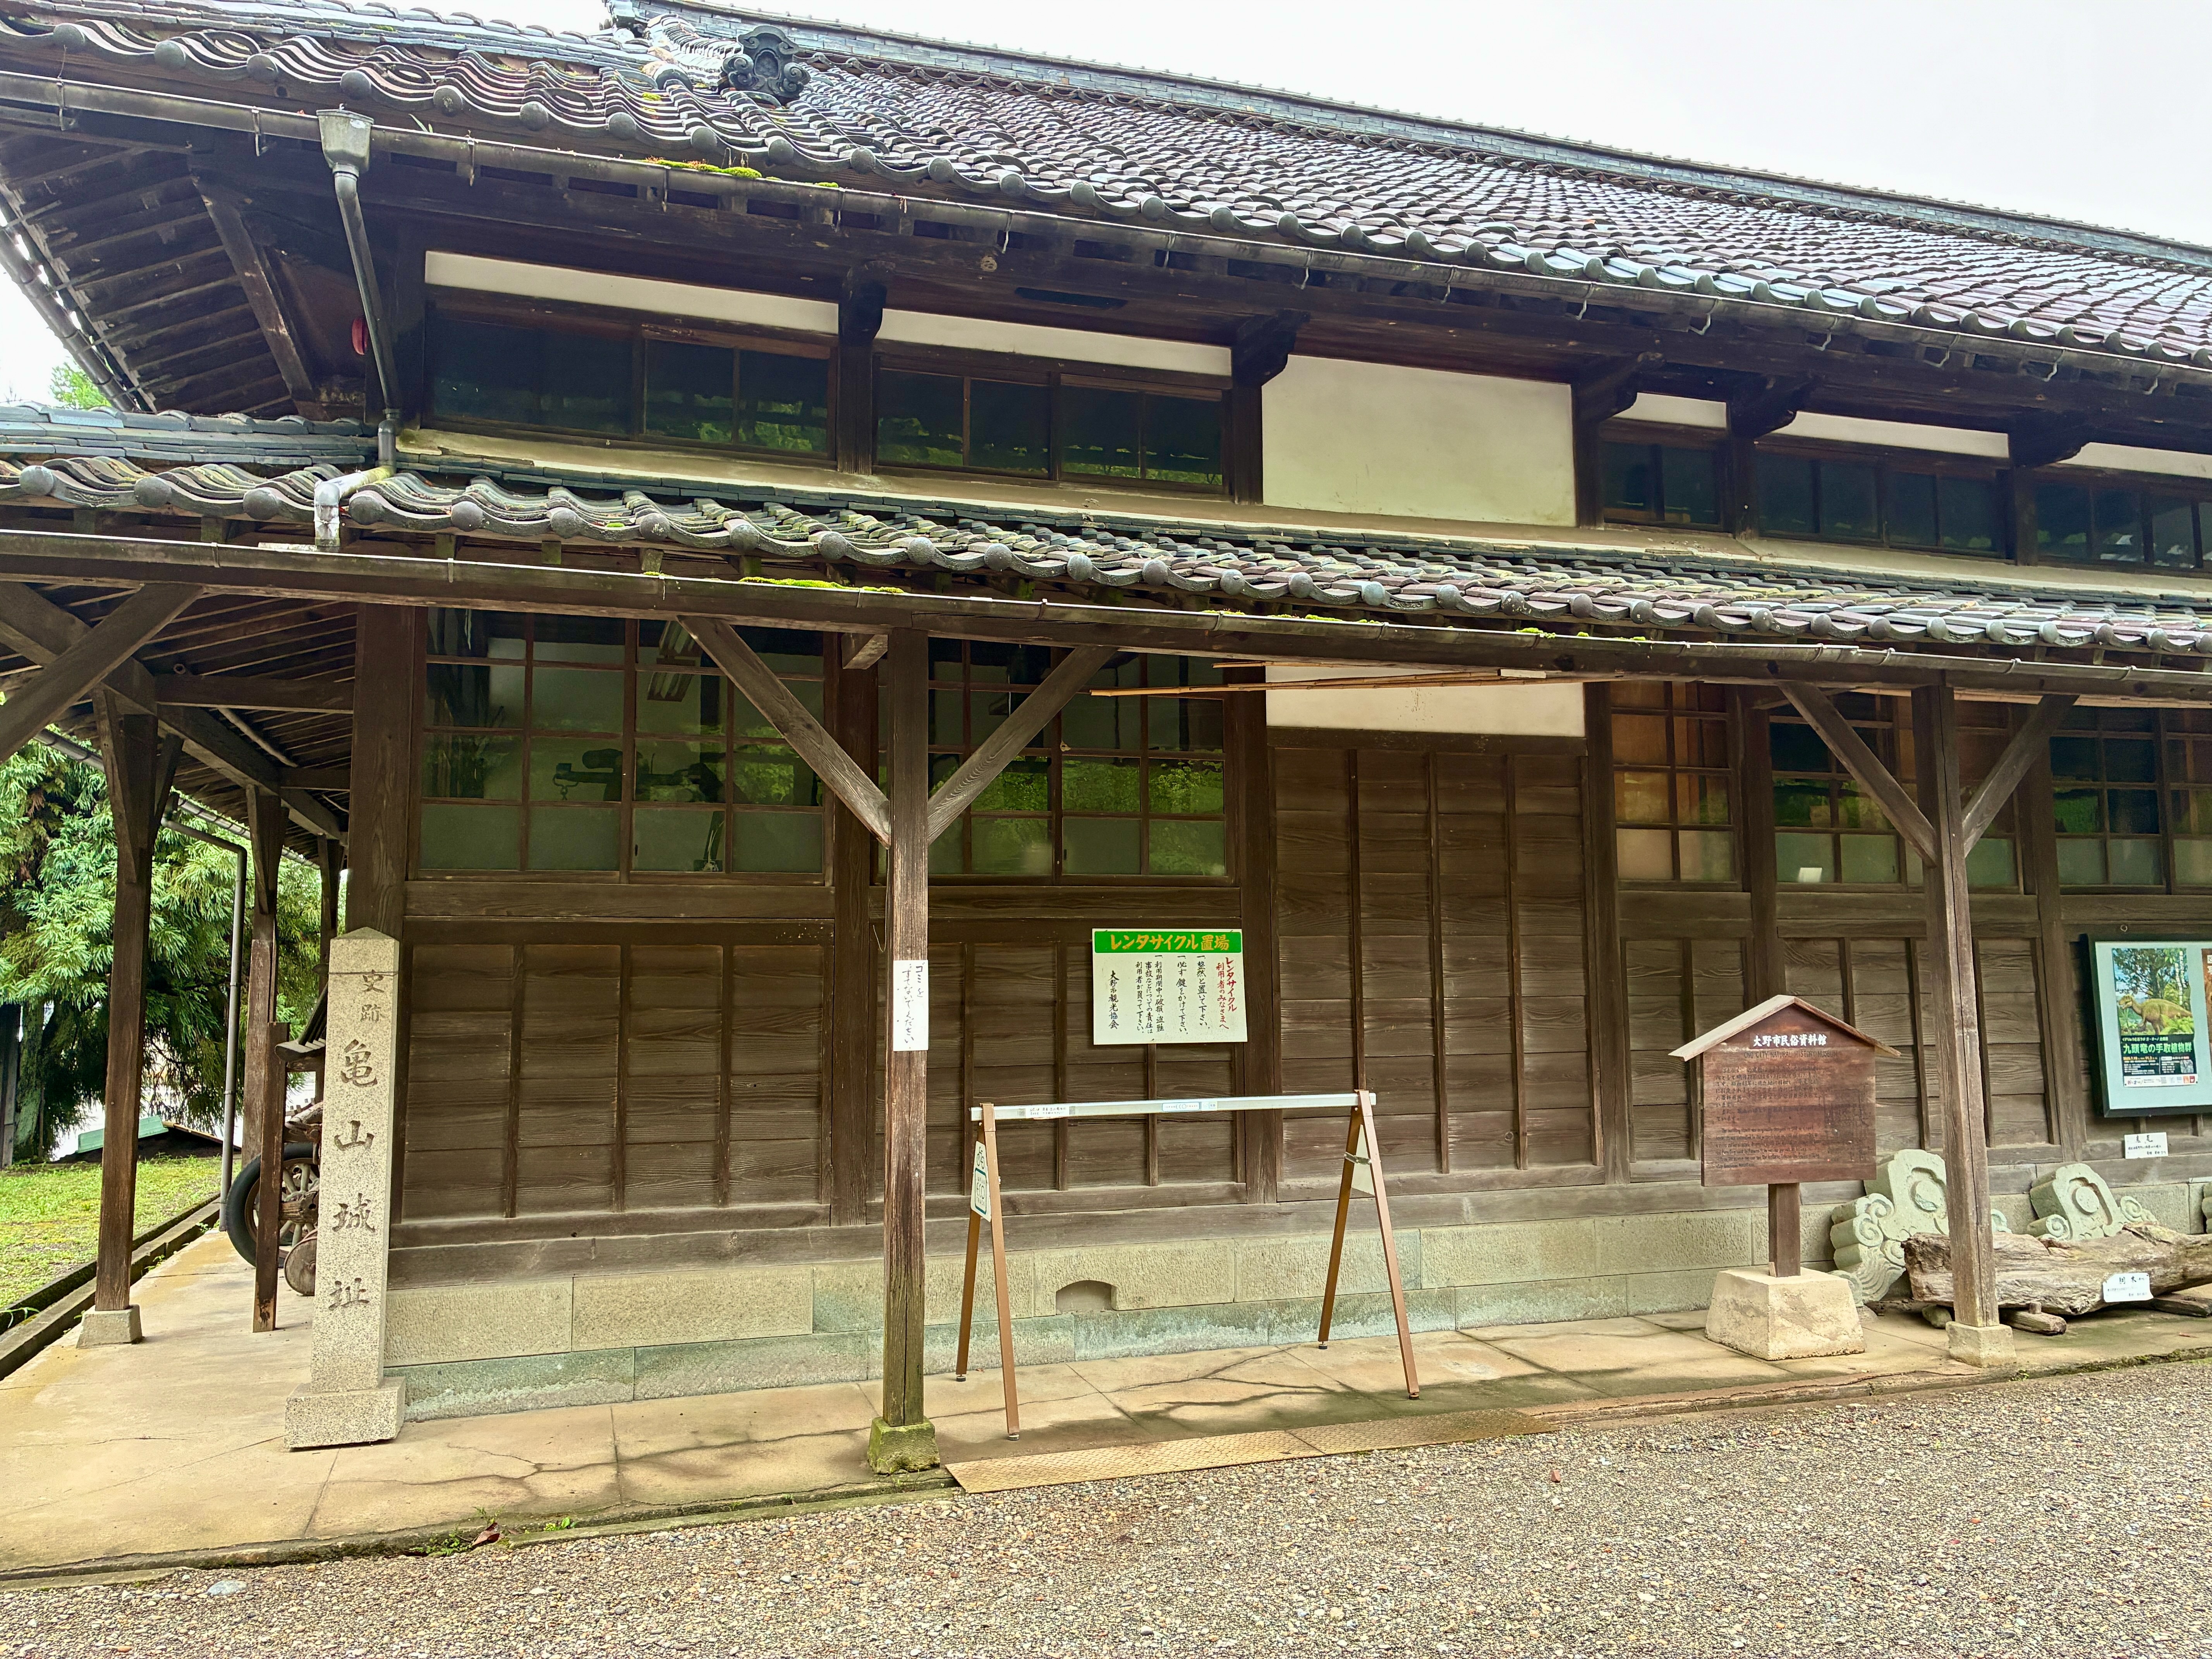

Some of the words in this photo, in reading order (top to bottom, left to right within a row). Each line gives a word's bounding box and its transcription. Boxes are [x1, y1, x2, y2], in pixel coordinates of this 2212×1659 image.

[1110, 934, 1230, 951] レンタサイクル置場
[360, 969, 389, 1023] 史跡
[1108, 970, 1120, 1029] 大野市観光協会
[1216, 962, 1229, 1029] 利用者のみなさまへ
[1225, 957, 1237, 1012] レンタサイクル
[1753, 1033, 1827, 1048] 大野市民俗資料館
[2123, 1042, 2192, 1054] 九頭竜の手取植物群
[328, 1039, 378, 1311] 亀山城址
